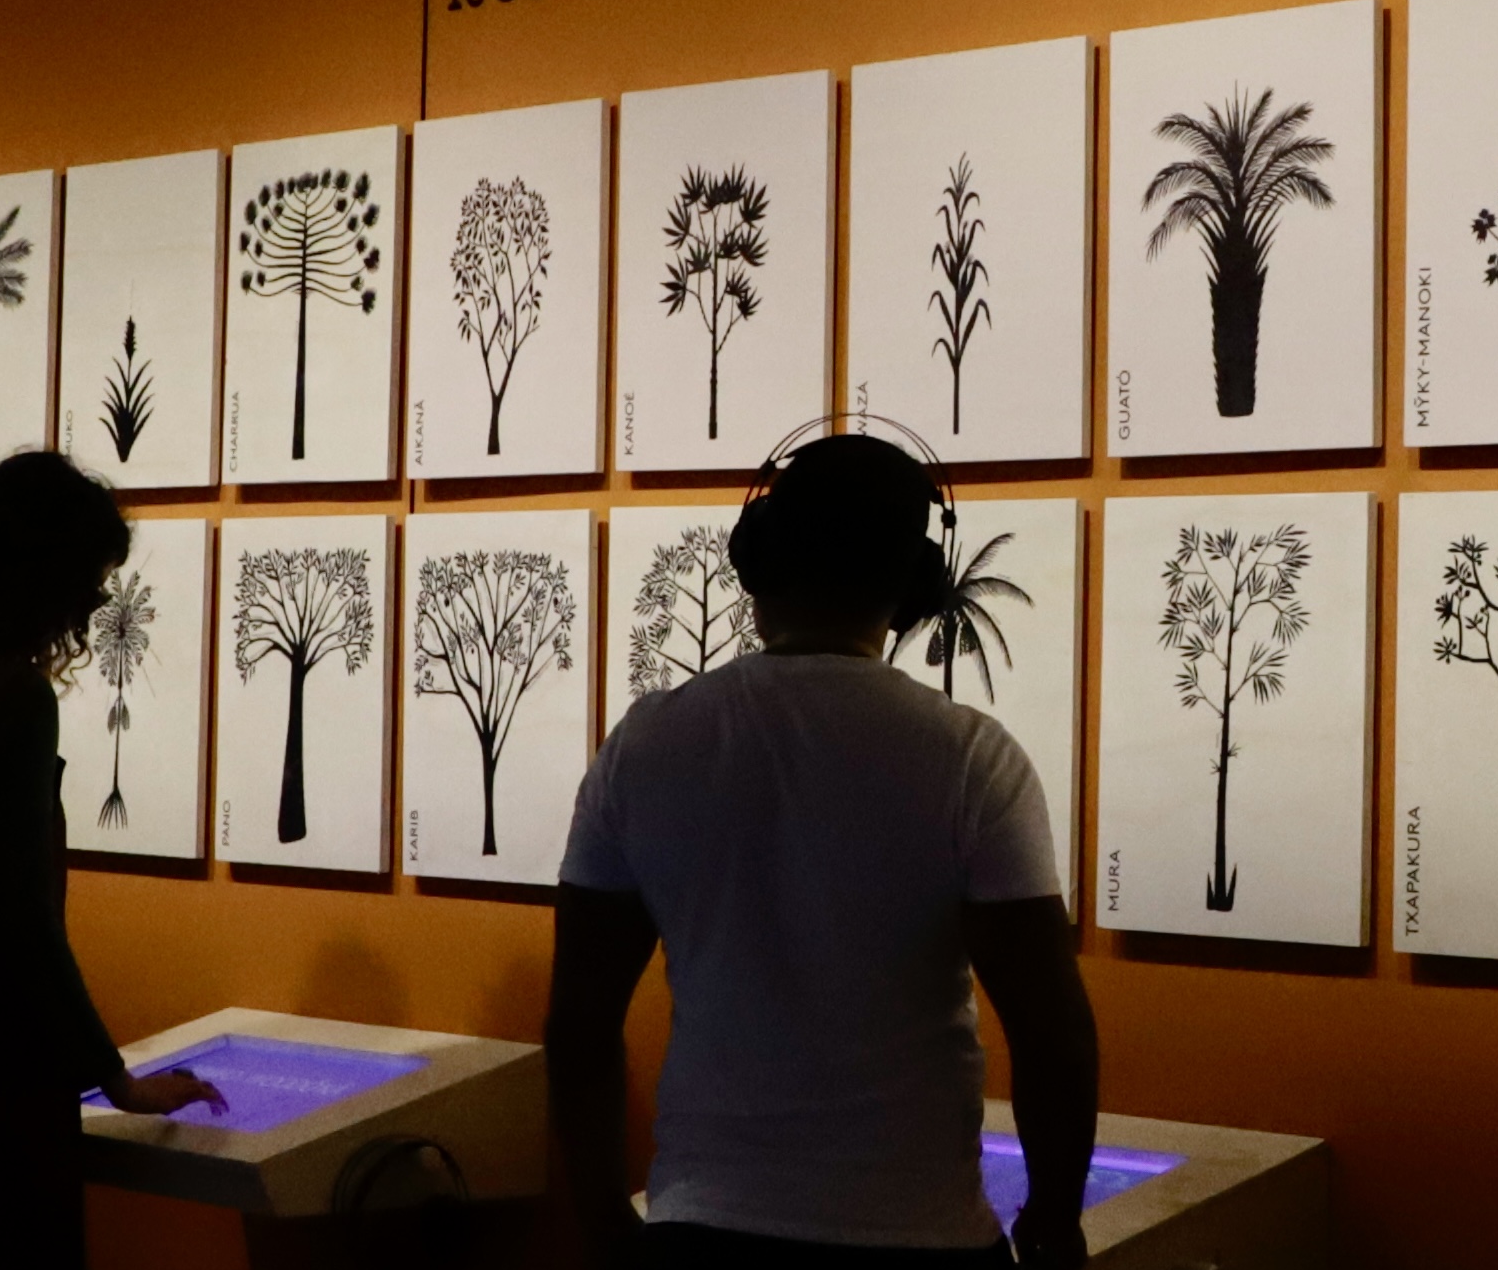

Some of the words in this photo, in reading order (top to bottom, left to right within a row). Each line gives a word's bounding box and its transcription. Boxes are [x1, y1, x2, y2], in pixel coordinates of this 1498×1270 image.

[229, 391, 240, 473] CHARRUA
[623, 391, 635, 456] KANOÉ
[855, 380, 869, 436] WAZÁ
[1116, 369, 1131, 441] GUATÓ
[221, 799, 231, 847] PANO
[1107, 850, 1120, 912] MURA
[1404, 806, 1420, 937] TXAPAKURA
